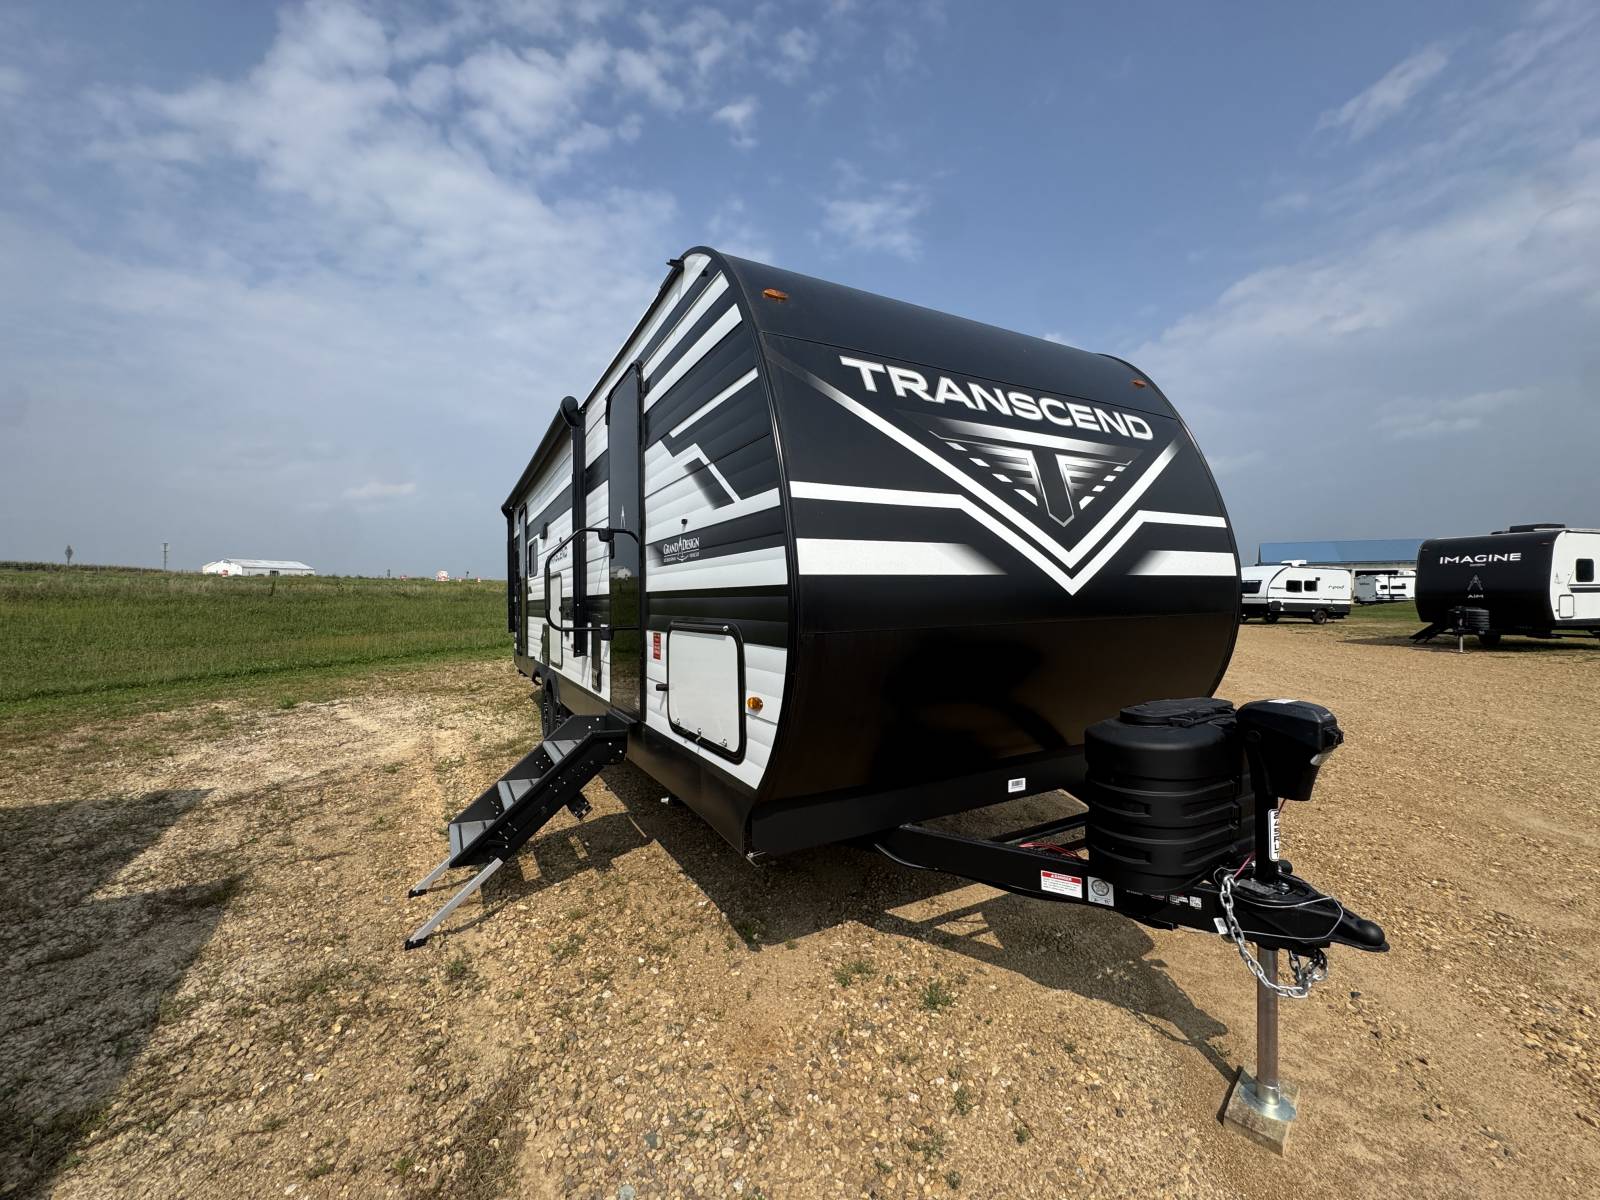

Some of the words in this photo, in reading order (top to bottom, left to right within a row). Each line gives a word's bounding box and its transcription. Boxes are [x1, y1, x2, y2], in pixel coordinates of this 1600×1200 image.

[839, 355, 1154, 441] TRANSCEND
[663, 542, 678, 554] GRAND
[682, 537, 700, 551] DESIGN
[1439, 552, 1522, 564] IMAGINE
